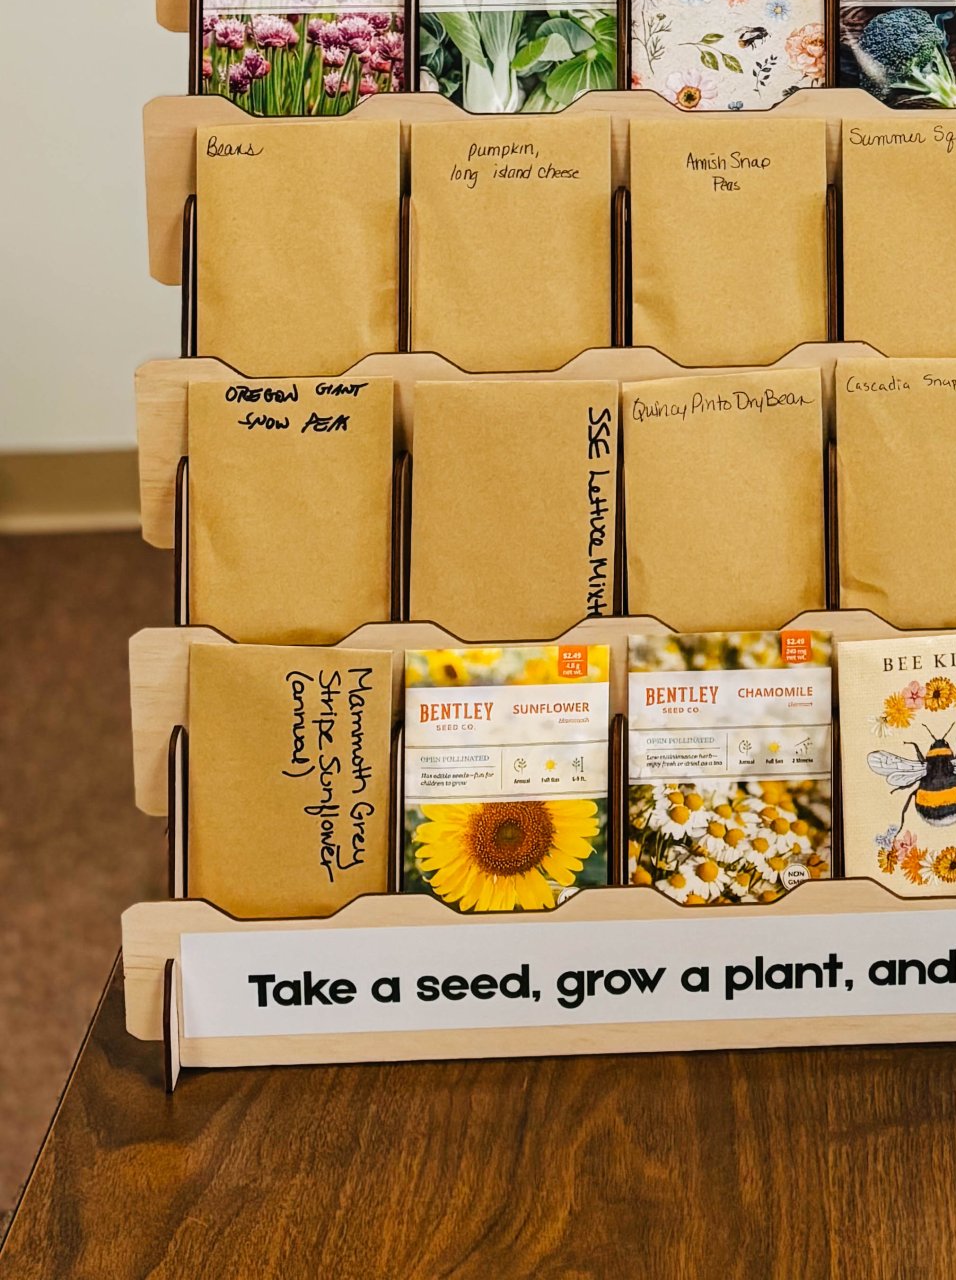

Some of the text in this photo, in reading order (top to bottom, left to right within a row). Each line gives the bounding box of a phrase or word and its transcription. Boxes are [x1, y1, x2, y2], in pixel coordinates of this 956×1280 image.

[207, 136, 263, 157] Beans
[849, 127, 924, 146] Summer
[686, 151, 771, 171] Amish Snap
[450, 164, 581, 189] long island cheese
[713, 176, 740, 192] Peas
[225, 383, 368, 403] OREGON GIANT
[846, 375, 911, 393] Cascadia
[632, 395, 687, 422] Quincy
[691, 395, 733, 416] Pinto
[238, 412, 350, 433] SNOW PEA
[588, 407, 611, 460] SSE
[588, 471, 610, 556] Lettuce
[883, 655, 922, 672] BEE
[646, 686, 718, 706] BENTLEY
[738, 687, 812, 698] CHAMOMILE
[420, 702, 493, 723] BENTLEY
[513, 703, 589, 714] SUNFLOWER
[282, 671, 315, 777] (annual)
[304, 670, 341, 882] Stripe Sunflower
[336, 668, 374, 870] Mammoth Grey
[248, 971, 356, 1007] Take
[372, 977, 400, 1002] a
[417, 964, 540, 1002] seed,
[557, 968, 666, 1008] grow
[681, 967, 709, 992] a
[726, 954, 853, 1000] plant,
[869, 949, 956, 986] and
